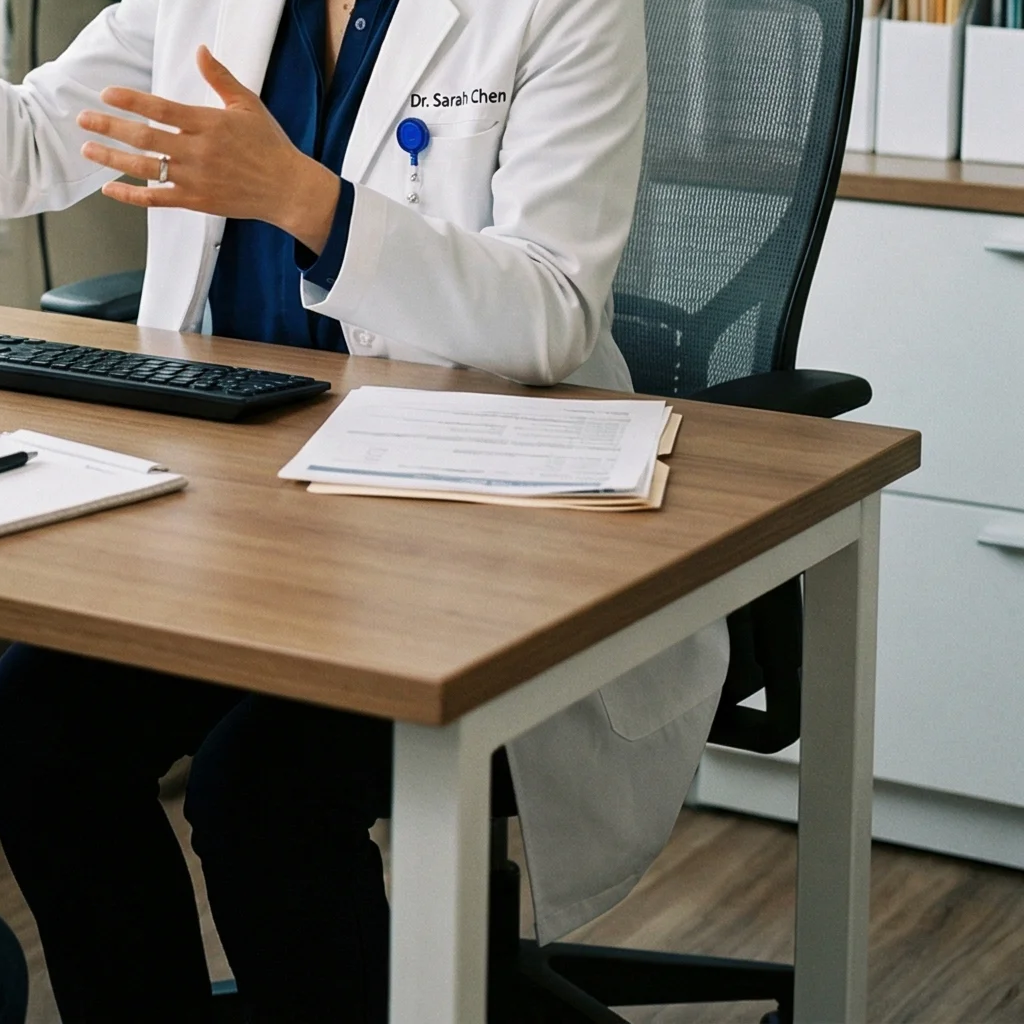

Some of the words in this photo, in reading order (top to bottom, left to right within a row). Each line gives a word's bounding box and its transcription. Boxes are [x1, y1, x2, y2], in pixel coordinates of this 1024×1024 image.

[410, 93, 429, 108] Dr.
[433, 91, 468, 108] Sarah
[471, 88, 506, 104] Chen
